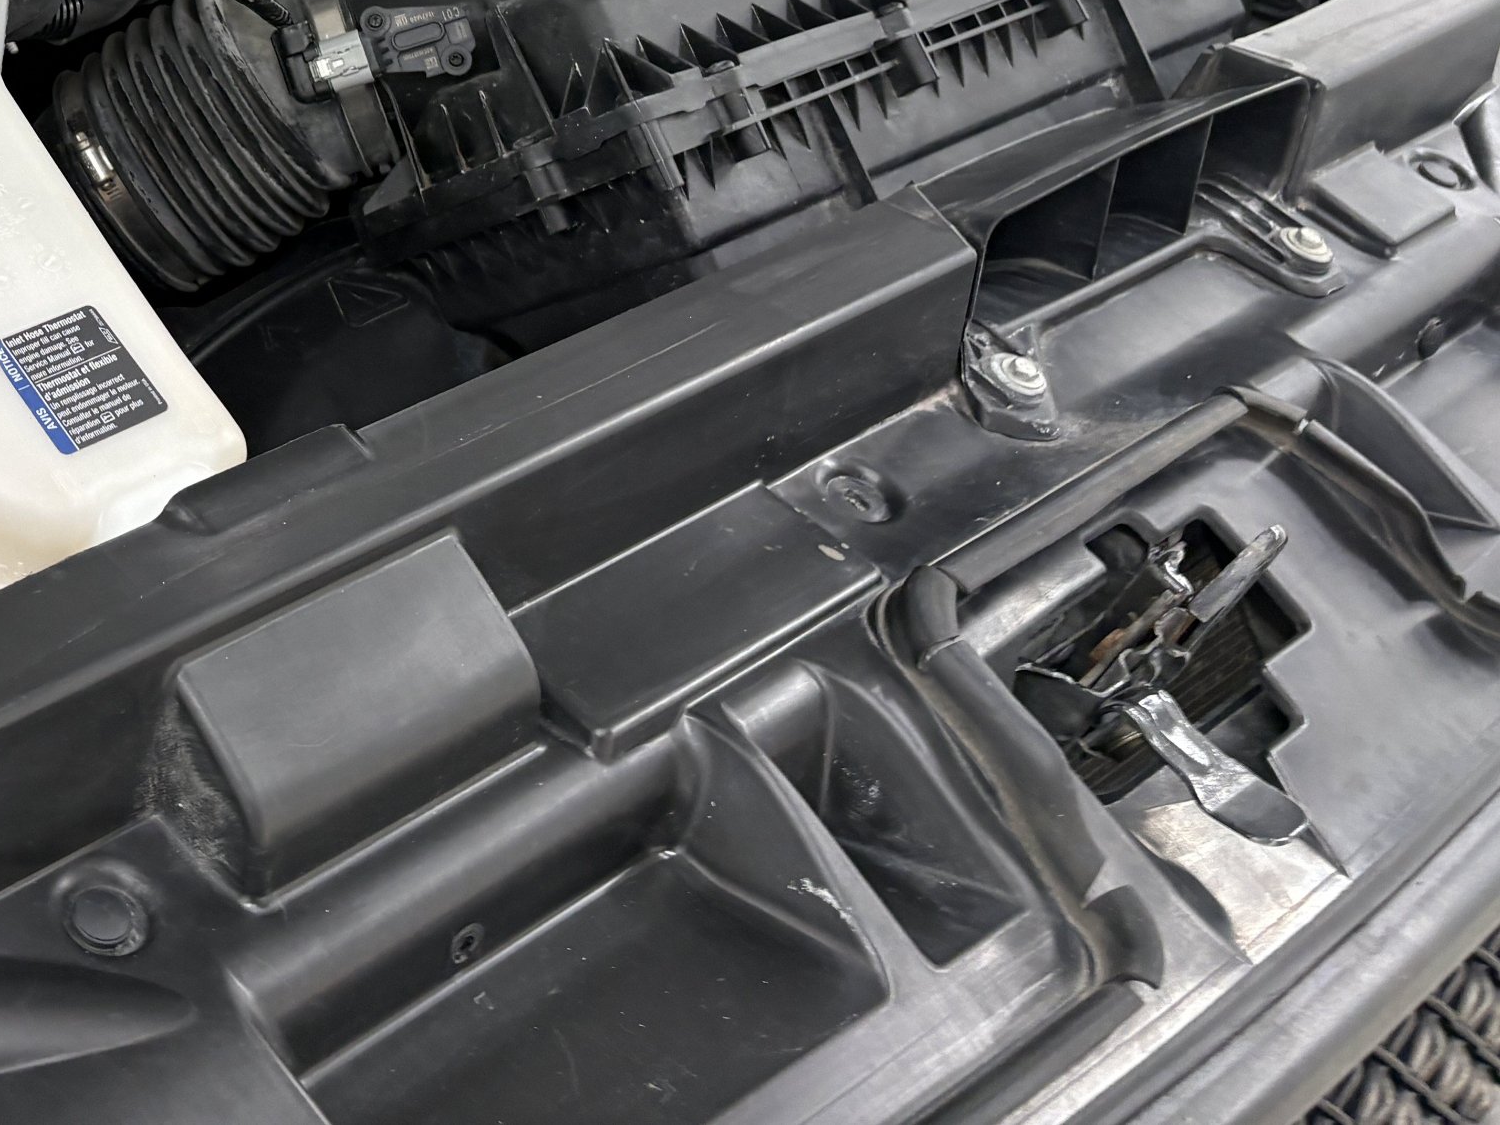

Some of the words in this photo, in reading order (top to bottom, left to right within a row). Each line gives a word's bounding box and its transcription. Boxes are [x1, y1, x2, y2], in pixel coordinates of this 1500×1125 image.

[5, 337, 24, 349] Inlet
[24, 328, 45, 343] Hose
[44, 310, 87, 333] Thermostat
[12, 338, 41, 357] Improper
[61, 325, 81, 337] cause
[18, 349, 41, 366] engine
[65, 336, 80, 346] See
[23, 359, 49, 373] Service
[47, 349, 72, 363] Manual
[30, 371, 47, 382] more
[36, 370, 80, 392] Thermostat
[90, 353, 119, 371] flexible
[59, 386, 98, 407] remplissage
[96, 373, 126, 391] incorrect
[35, 407, 58, 430] AVIS
[56, 408, 72, 420] peut
[71, 394, 111, 414] endommager
[61, 410, 92, 428] Consulter
[98, 398, 123, 413] manuel
[114, 405, 130, 418] pour
[128, 398, 144, 413] plus
